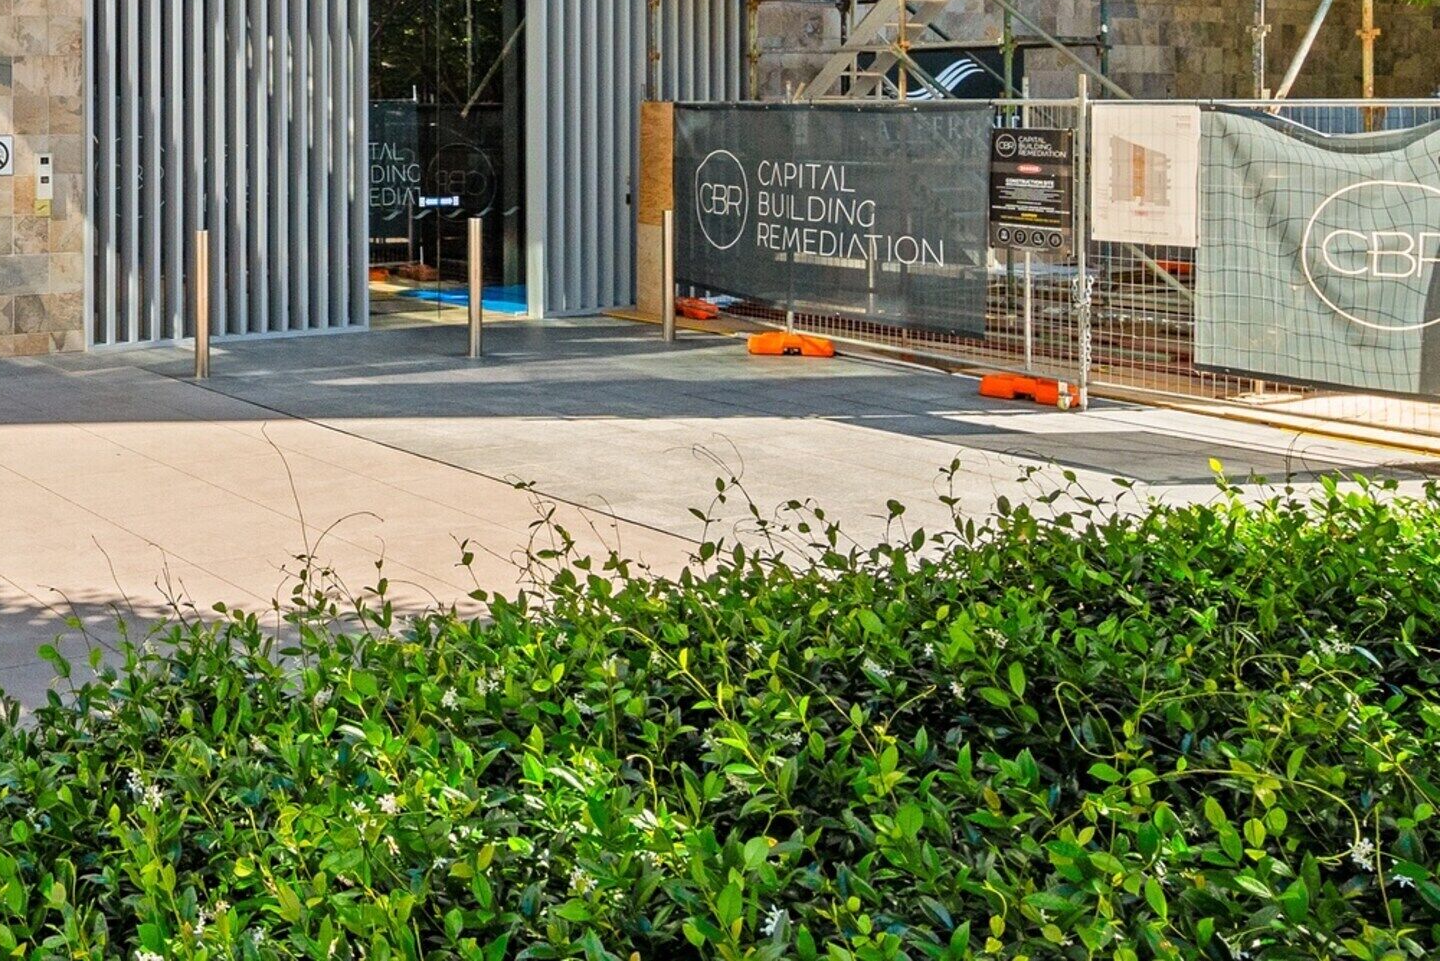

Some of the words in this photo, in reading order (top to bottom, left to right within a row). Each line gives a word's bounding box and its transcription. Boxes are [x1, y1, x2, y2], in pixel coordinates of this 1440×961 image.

[1017, 135, 1047, 144] CAPITAL
[757, 159, 856, 193] CAPITAL
[699, 182, 743, 217] CBR
[758, 191, 877, 228] BUILDING
[756, 222, 945, 268] REMEDIATION
